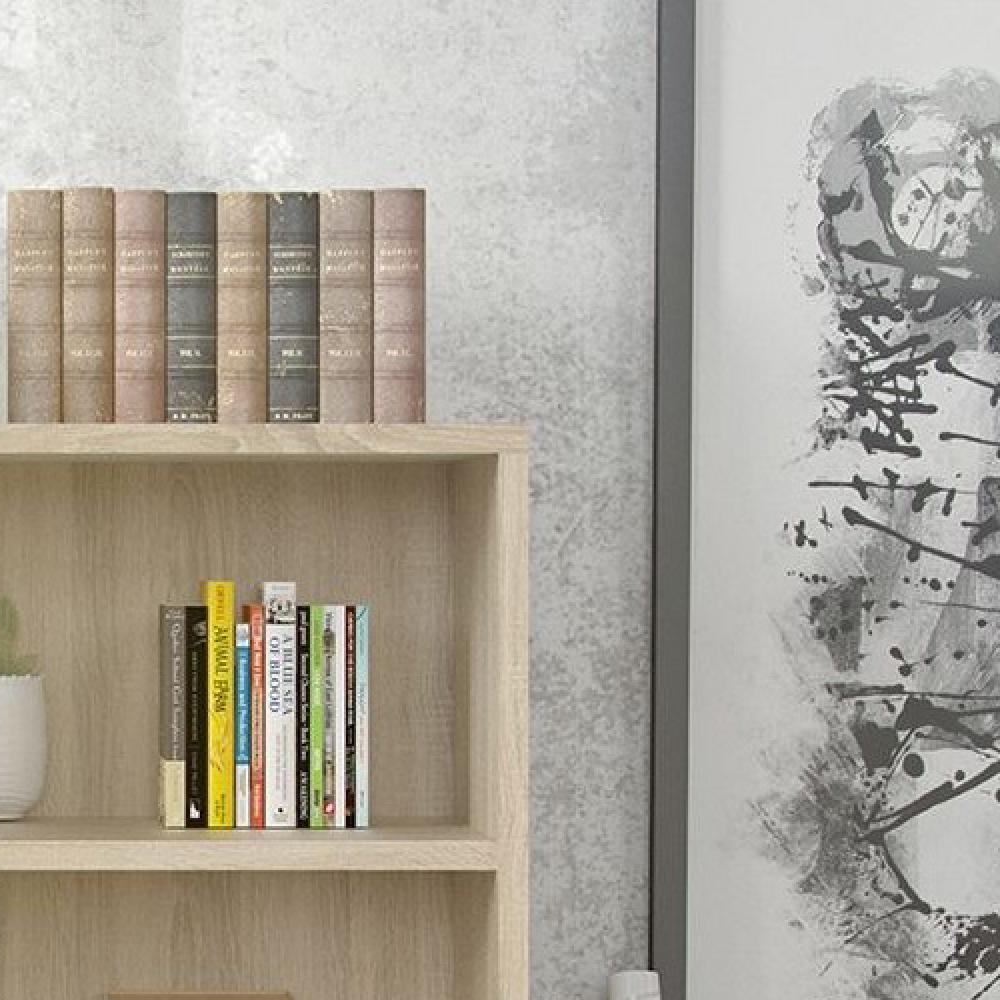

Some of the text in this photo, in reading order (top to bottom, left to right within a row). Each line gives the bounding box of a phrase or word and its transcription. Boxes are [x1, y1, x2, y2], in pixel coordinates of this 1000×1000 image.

[214, 625, 229, 674] ANIMAL
[283, 635, 293, 644] A
[269, 637, 280, 714] OF BLOOD
[283, 648, 293, 686] BLUE
[283, 689, 293, 715] SEA
